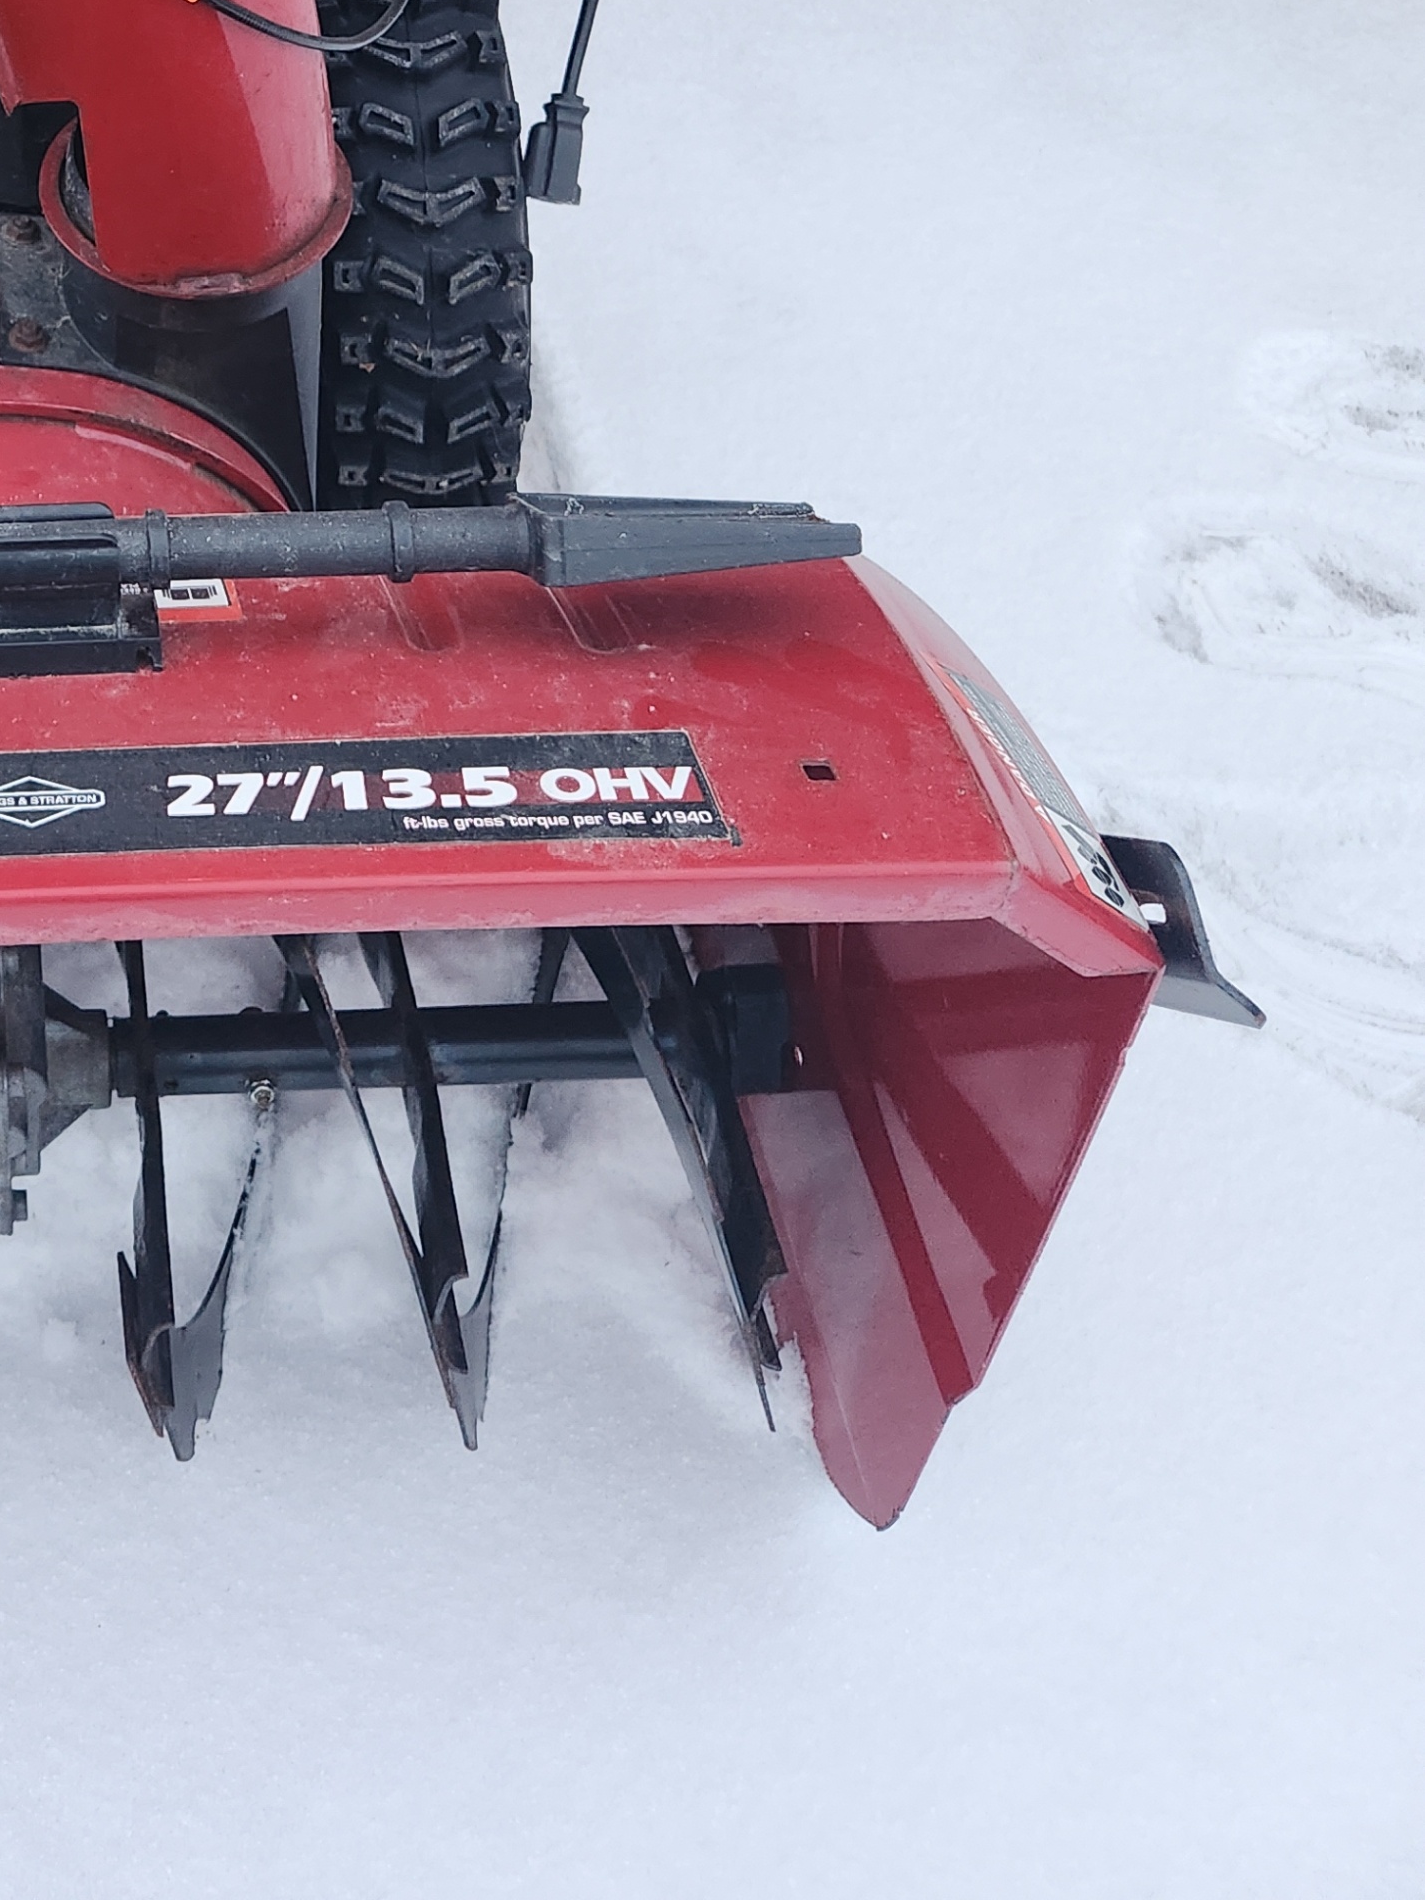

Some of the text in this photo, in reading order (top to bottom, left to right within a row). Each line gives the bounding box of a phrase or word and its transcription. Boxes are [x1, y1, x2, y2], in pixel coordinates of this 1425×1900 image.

[539, 766, 694, 804] OHV
[18, 796, 27, 805] &
[30, 794, 97, 806] STRATTON
[403, 810, 714, 831] ft-lbs gross torque per SAE J1940
